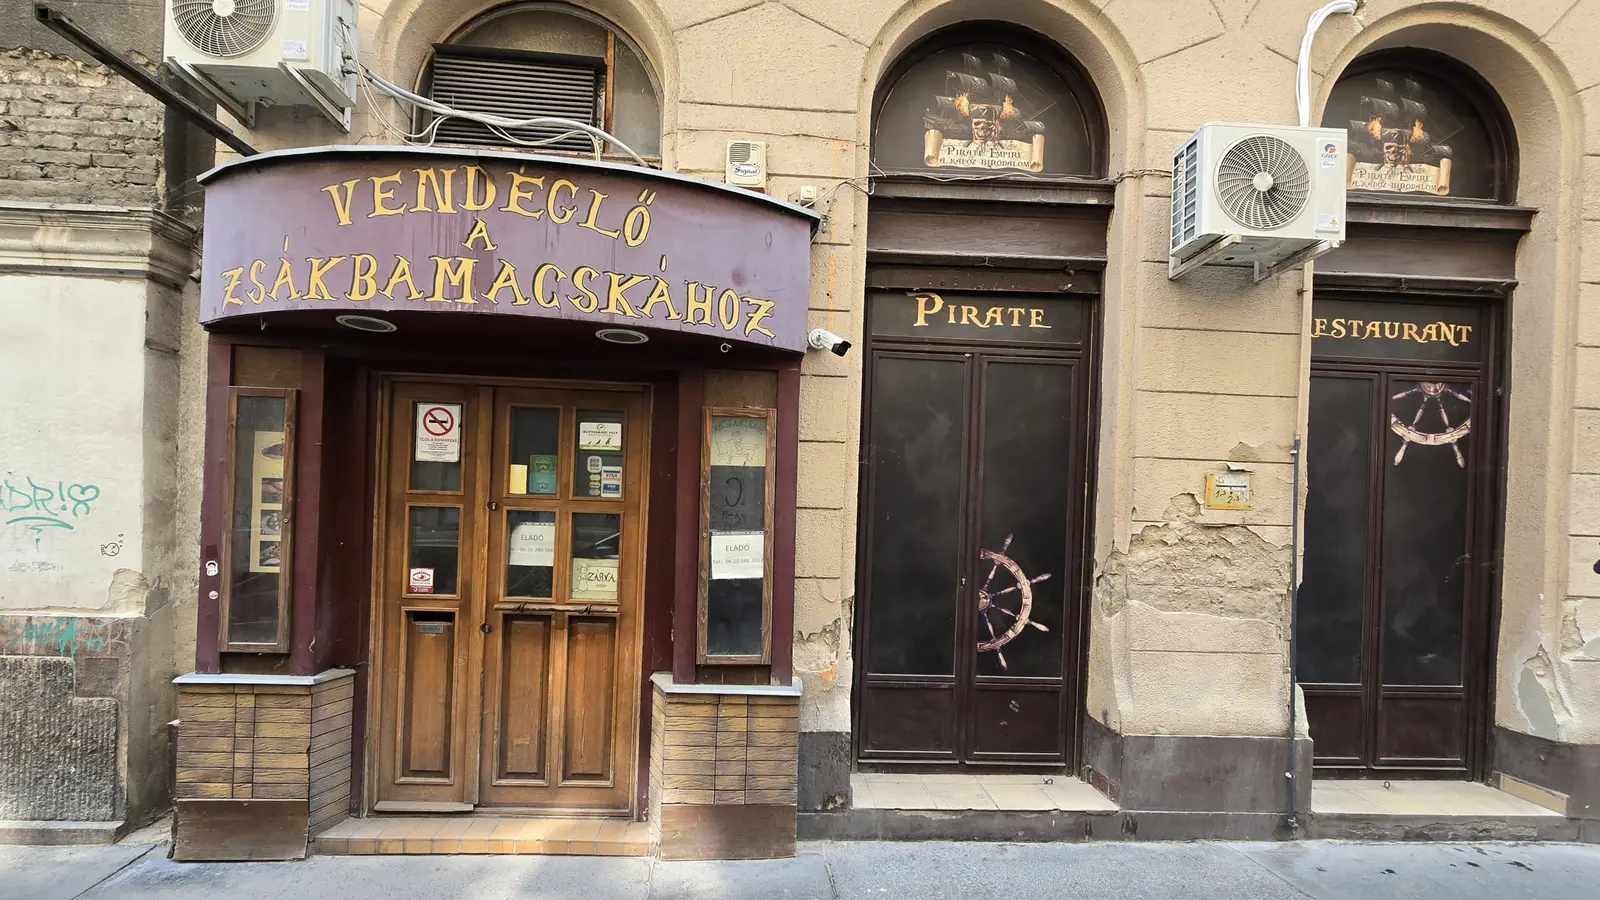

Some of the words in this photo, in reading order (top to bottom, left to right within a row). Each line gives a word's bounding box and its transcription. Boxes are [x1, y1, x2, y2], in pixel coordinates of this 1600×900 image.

[734, 167, 758, 175] Signal
[321, 165, 657, 249] VENDÉGLŐ
[462, 217, 498, 252] A
[221, 234, 777, 339] ZSÁKBAMACSKÁHOZ
[905, 292, 1052, 329] PIRATE
[1311, 318, 1473, 347] ESTAURANT
[521, 534, 544, 542] ELADÓ
[725, 544, 750, 552] ELADÓ
